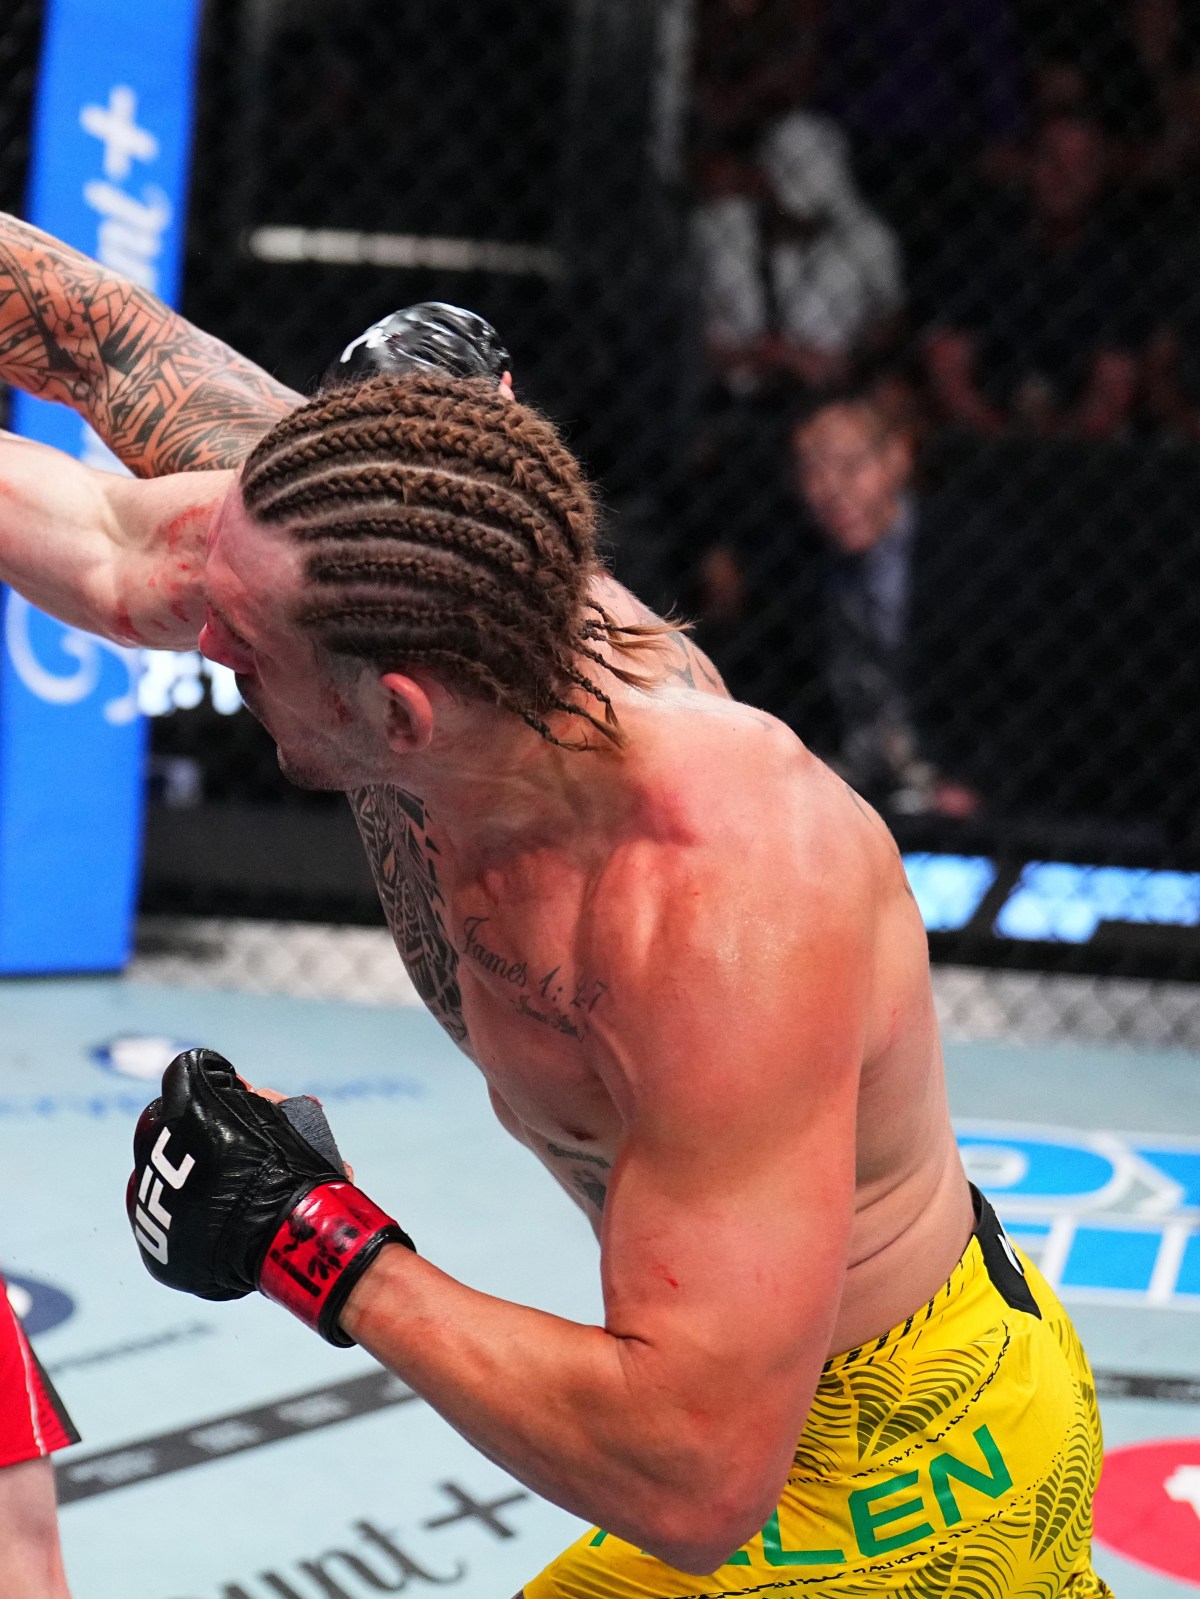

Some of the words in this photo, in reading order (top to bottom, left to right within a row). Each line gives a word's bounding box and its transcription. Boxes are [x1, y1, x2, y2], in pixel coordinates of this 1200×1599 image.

[463, 916, 528, 988] James
[134, 1126, 197, 1266] UFC
[589, 1424, 1014, 1567] LEN
